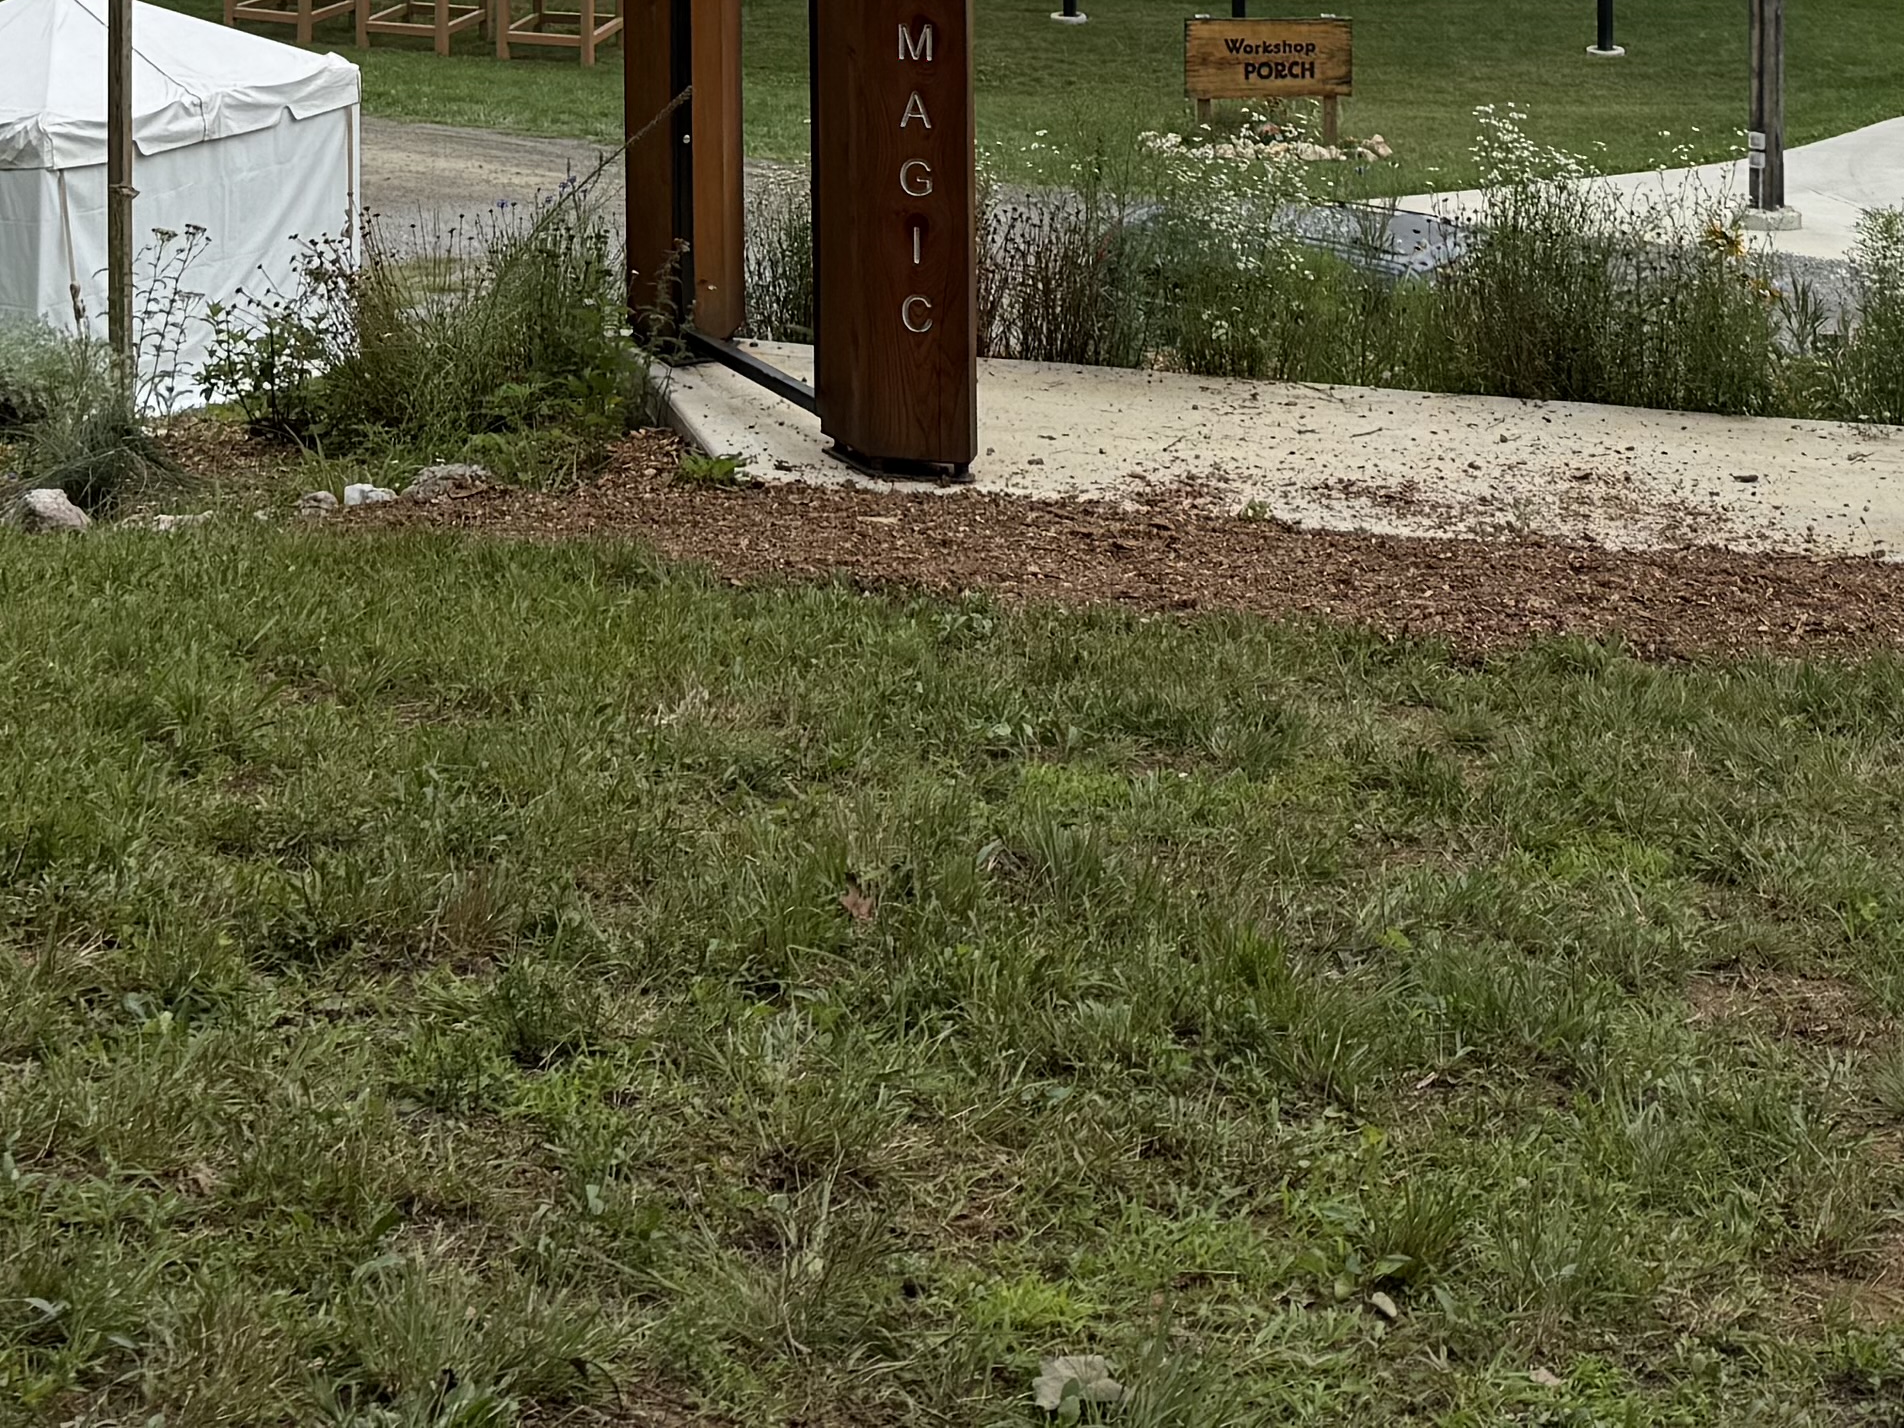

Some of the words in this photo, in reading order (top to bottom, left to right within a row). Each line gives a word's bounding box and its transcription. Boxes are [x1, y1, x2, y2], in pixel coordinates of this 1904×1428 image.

[1224, 37, 1317, 57] Workshop
[1243, 60, 1315, 81] PORCH
[897, 23, 934, 333] MAGIC
